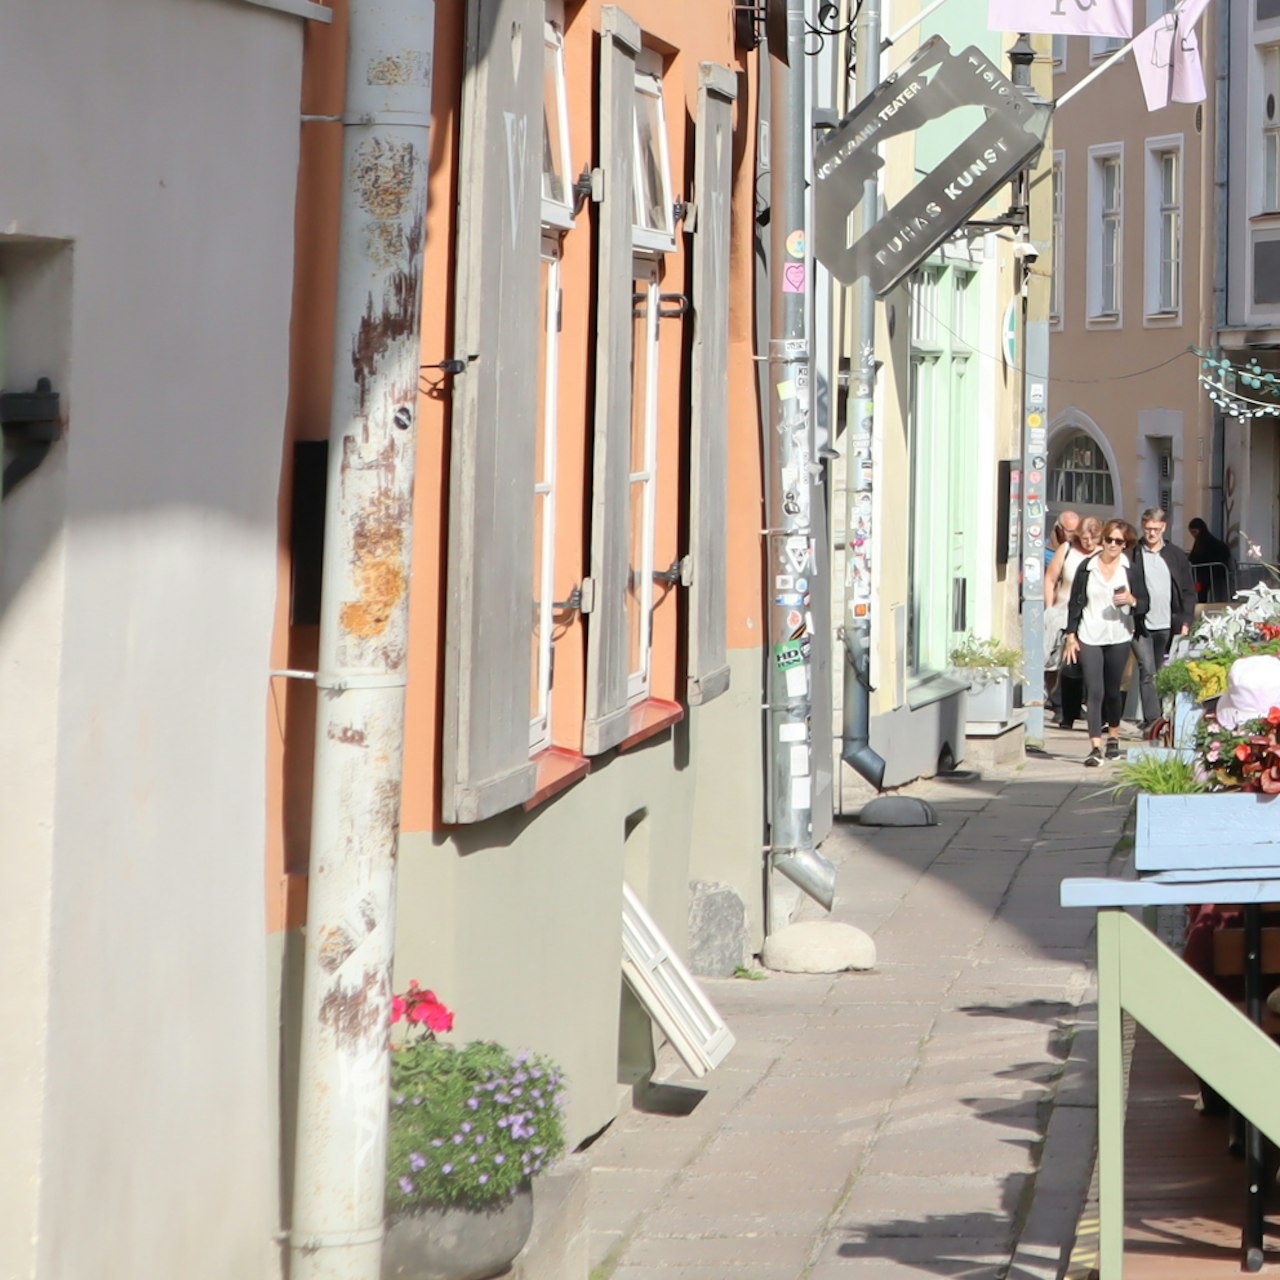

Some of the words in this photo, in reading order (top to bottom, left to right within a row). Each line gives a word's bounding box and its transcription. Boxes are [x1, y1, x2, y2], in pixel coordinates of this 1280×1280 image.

[878, 81, 922, 122] TEATER
[874, 200, 943, 266] PUHAS
[943, 135, 1010, 201] KUNST
